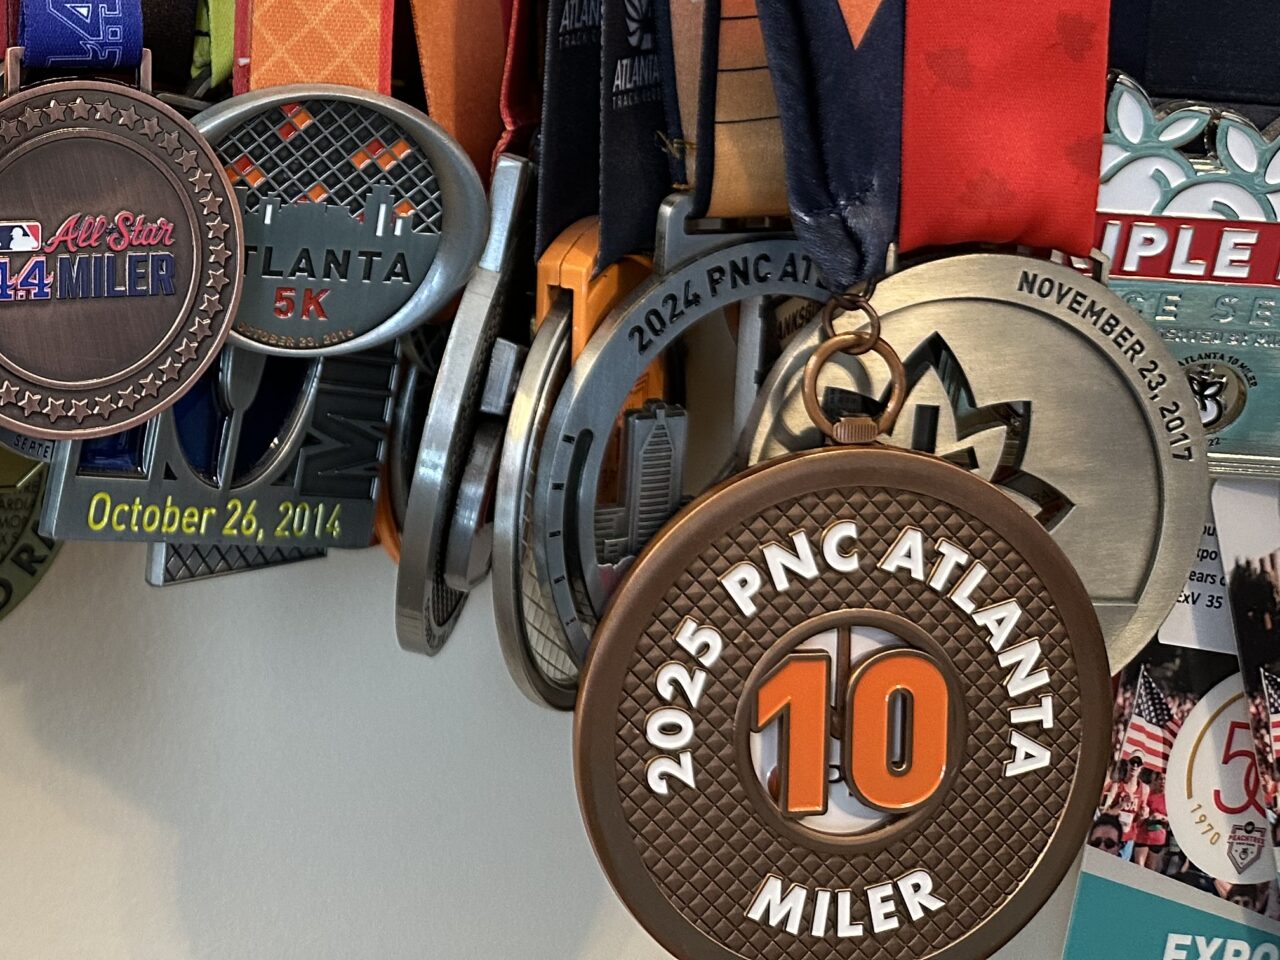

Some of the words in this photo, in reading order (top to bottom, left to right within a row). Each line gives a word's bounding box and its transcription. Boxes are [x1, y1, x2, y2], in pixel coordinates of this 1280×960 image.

[56, 251, 175, 299] MILER
[274, 287, 330, 320] 5K
[628, 280, 701, 356] 2024
[706, 253, 771, 297] PNC
[1017, 271, 1146, 365] NOVEMBER
[1138, 360, 1167, 401] 23,
[1160, 401, 1194, 462] 2017
[87, 492, 216, 535] October
[222, 498, 265, 542] 26,
[274, 501, 342, 539] 2014
[1205, 594, 1223, 609] 35
[646, 616, 723, 795] 2025
[721, 520, 860, 617] PNC
[878, 526, 1055, 779] ATLANTA
[753, 650, 950, 816] 10
[1190, 804, 1221, 846] 1970
[744, 868, 946, 938] MILER
